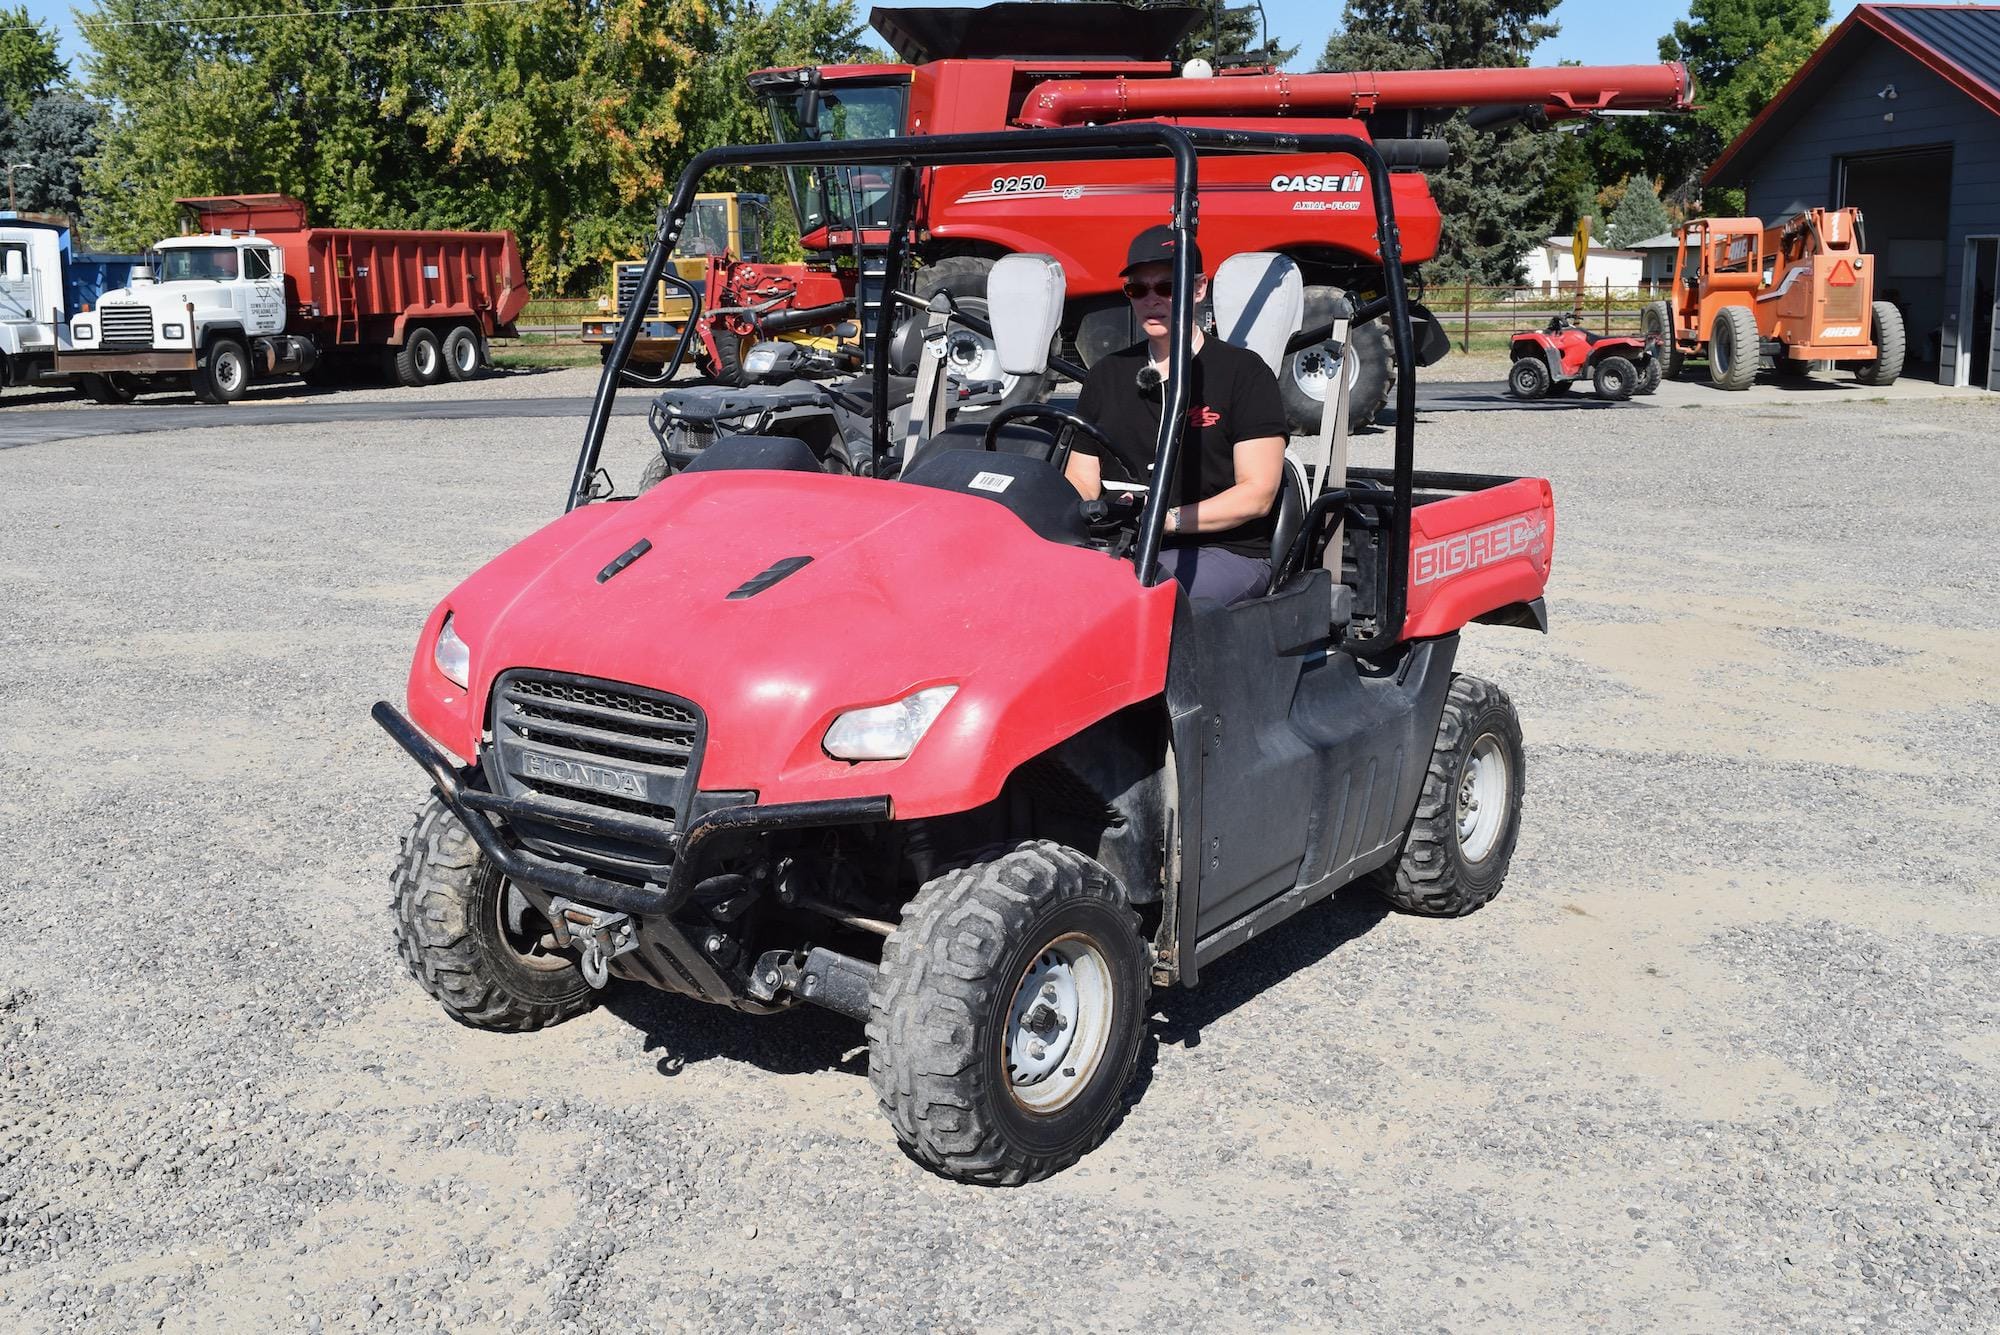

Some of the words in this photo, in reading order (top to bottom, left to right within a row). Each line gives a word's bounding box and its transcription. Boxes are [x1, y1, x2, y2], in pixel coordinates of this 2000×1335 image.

[992, 175, 1046, 193] 9250
[1270, 175, 1340, 192] CASE
[1292, 201, 1360, 211] AXIAL-FLOW
[182, 294, 188, 302] 3
[522, 750, 648, 799] HONDA
